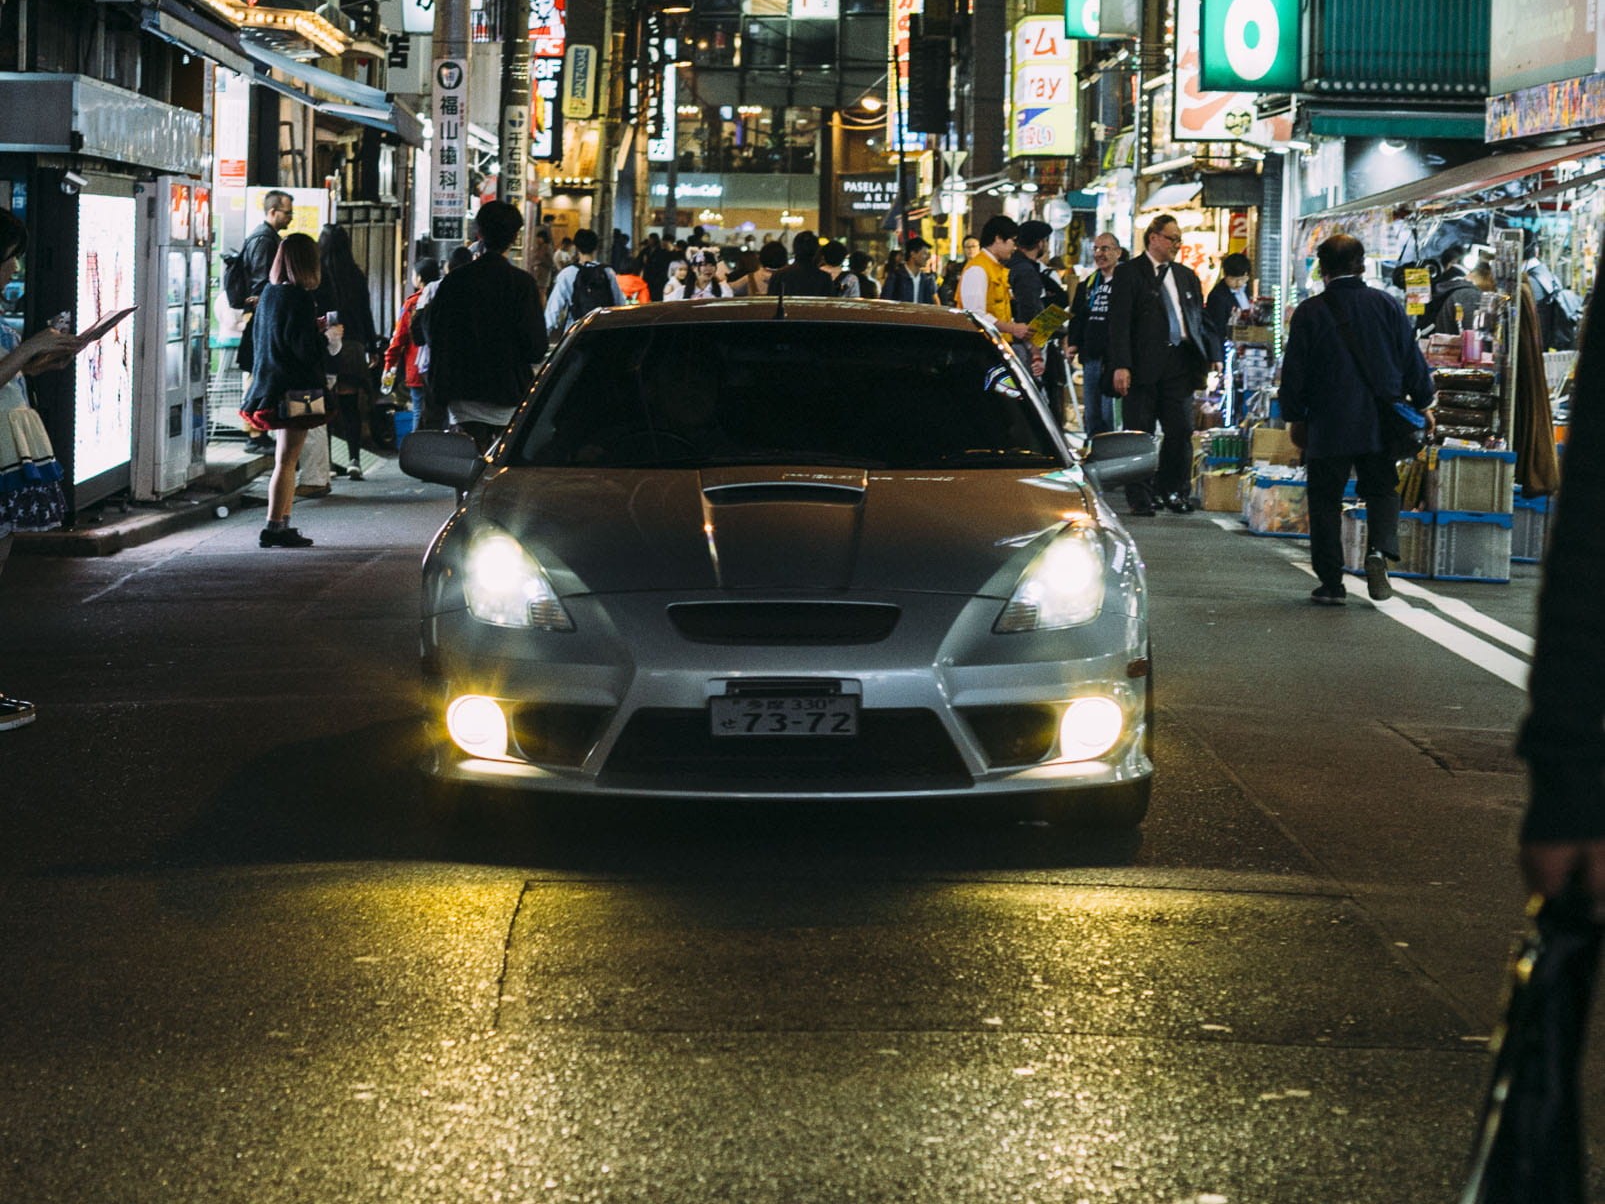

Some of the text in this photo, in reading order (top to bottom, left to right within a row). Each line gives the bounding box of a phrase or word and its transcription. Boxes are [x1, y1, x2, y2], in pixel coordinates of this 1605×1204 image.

[534, 39, 562, 54] FC
[843, 181, 883, 192] PASELA
[791, 699, 827, 710] 330
[742, 712, 851, 733] 73-72
